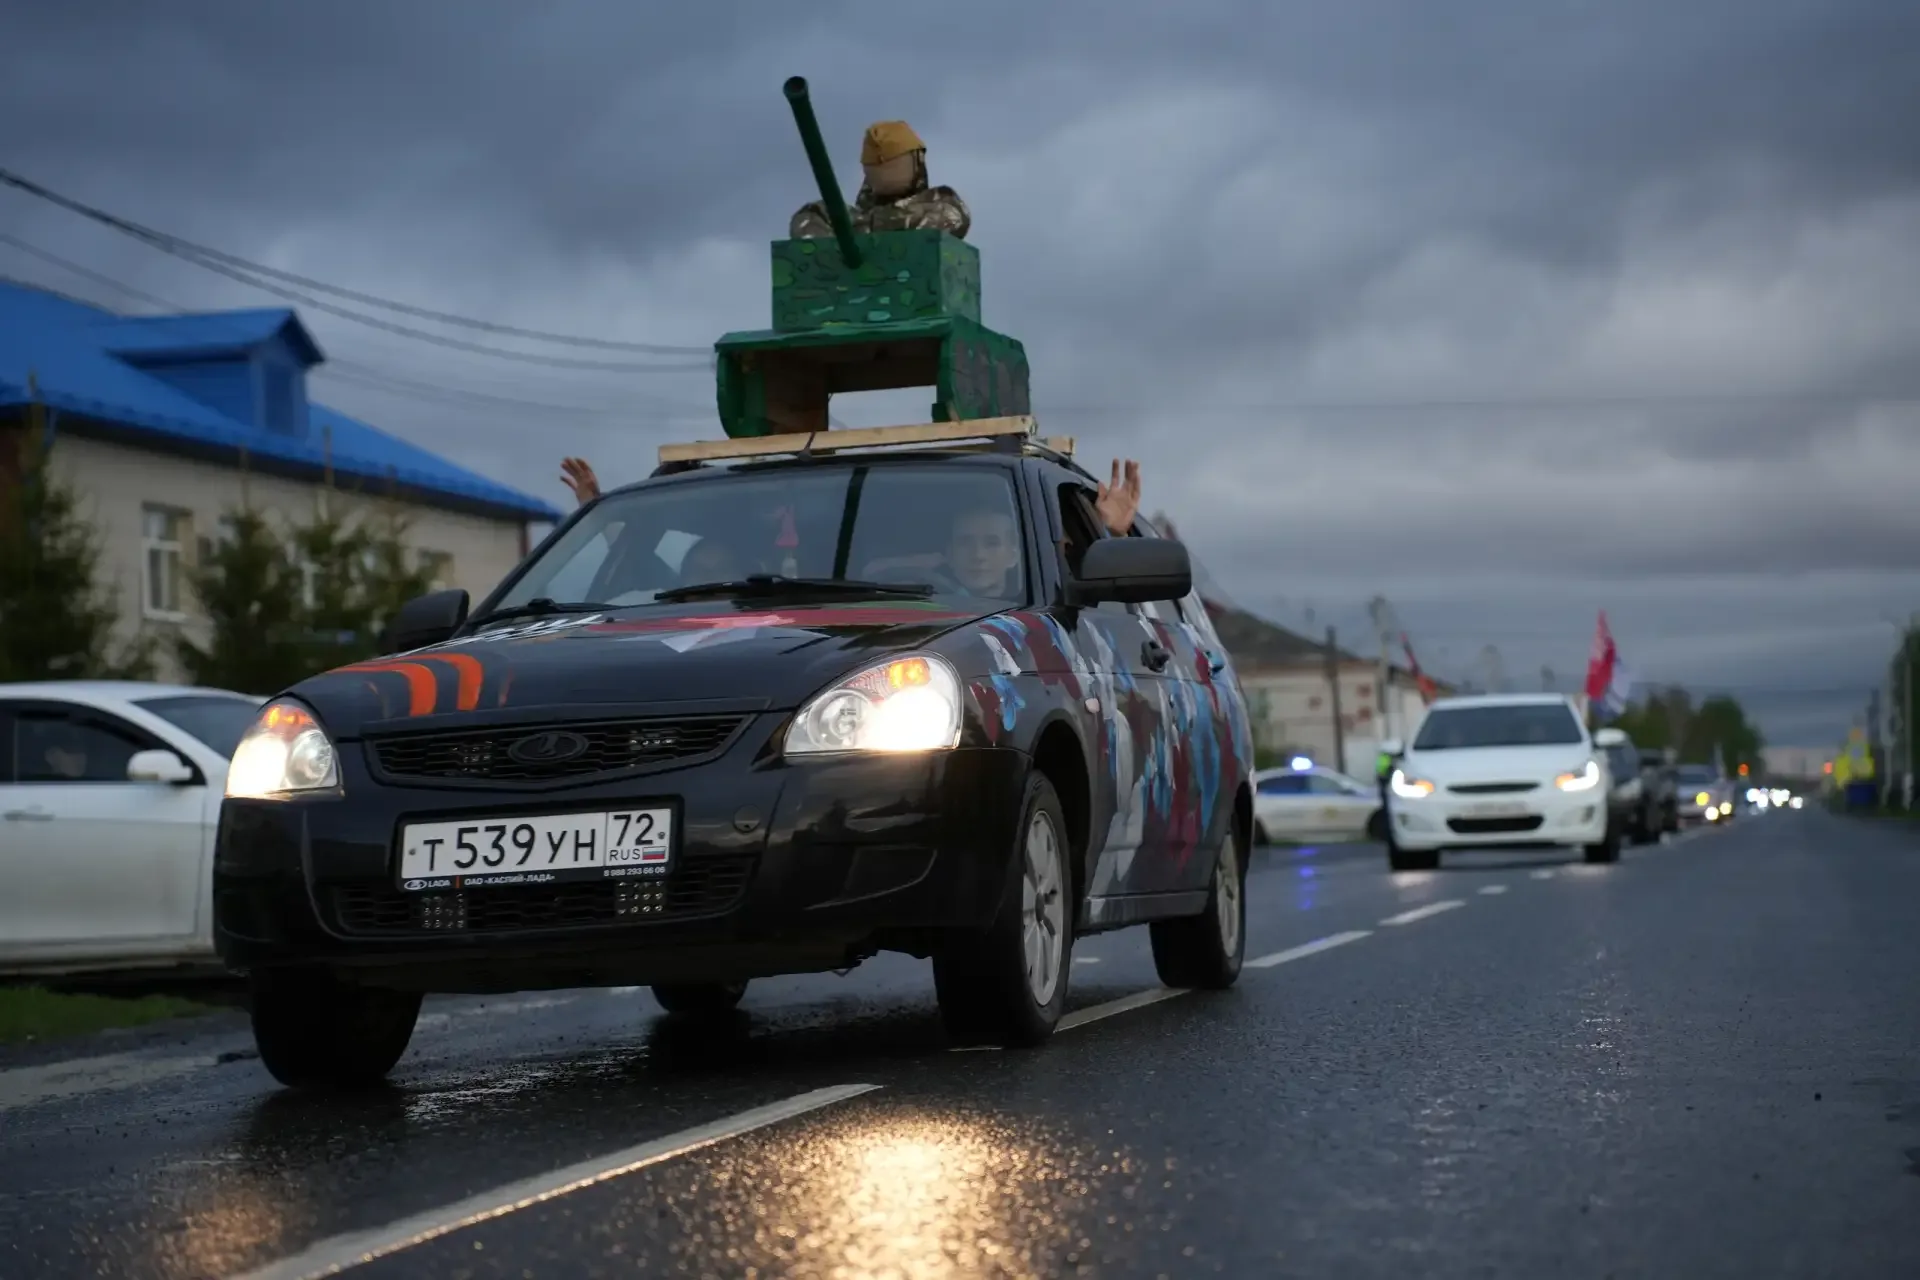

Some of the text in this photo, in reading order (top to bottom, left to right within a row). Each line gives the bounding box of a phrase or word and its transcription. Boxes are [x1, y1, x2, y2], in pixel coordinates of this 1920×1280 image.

[613, 813, 653, 846] 72
[610, 848, 640, 861] RUS
[428, 880, 451, 888] LADA
